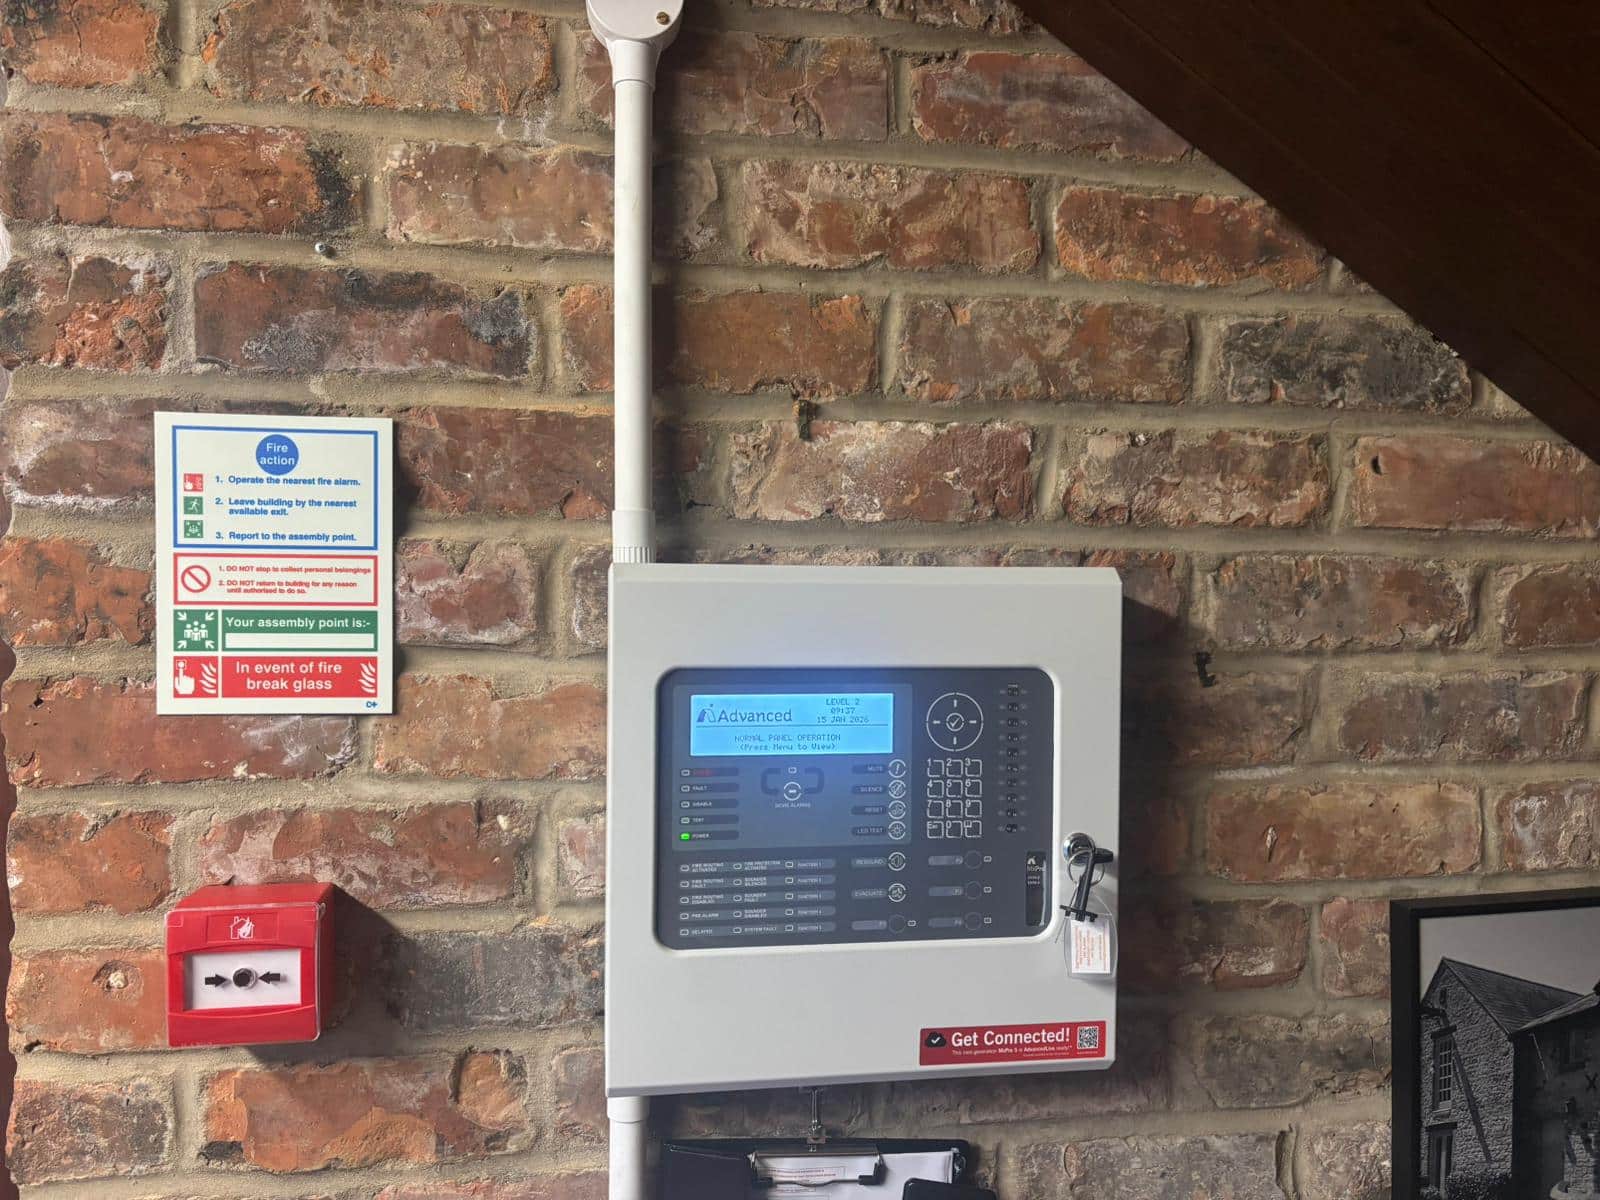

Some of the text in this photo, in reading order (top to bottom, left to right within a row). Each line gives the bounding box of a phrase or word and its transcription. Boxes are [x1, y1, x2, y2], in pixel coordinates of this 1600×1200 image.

[266, 443, 288, 453] Fire
[260, 456, 295, 465] action
[228, 476, 264, 485] Operate
[282, 477, 316, 485] nearest
[318, 477, 332, 485] fire
[334, 478, 360, 486] alarm.
[258, 498, 293, 508] building
[296, 499, 306, 508] by
[229, 508, 268, 516] available
[229, 532, 258, 540] Report
[288, 533, 330, 542] assembly
[332, 534, 356, 542] point.
[226, 617, 372, 630] Your assembly point is:-
[236, 662, 342, 674] In event of fire
[246, 678, 332, 692] break glass
[718, 709, 792, 722] Advanced
[928, 758, 932, 766] 1
[946, 758, 952, 766] 2
[965, 758, 970, 766] 3
[928, 779, 932, 788] 4
[946, 779, 952, 788] 5
[965, 779, 971, 788] 6
[927, 799, 932, 808] 7
[946, 799, 952, 808] 8
[966, 799, 971, 808] 9
[952, 1028, 1070, 1047] Get Connected!
